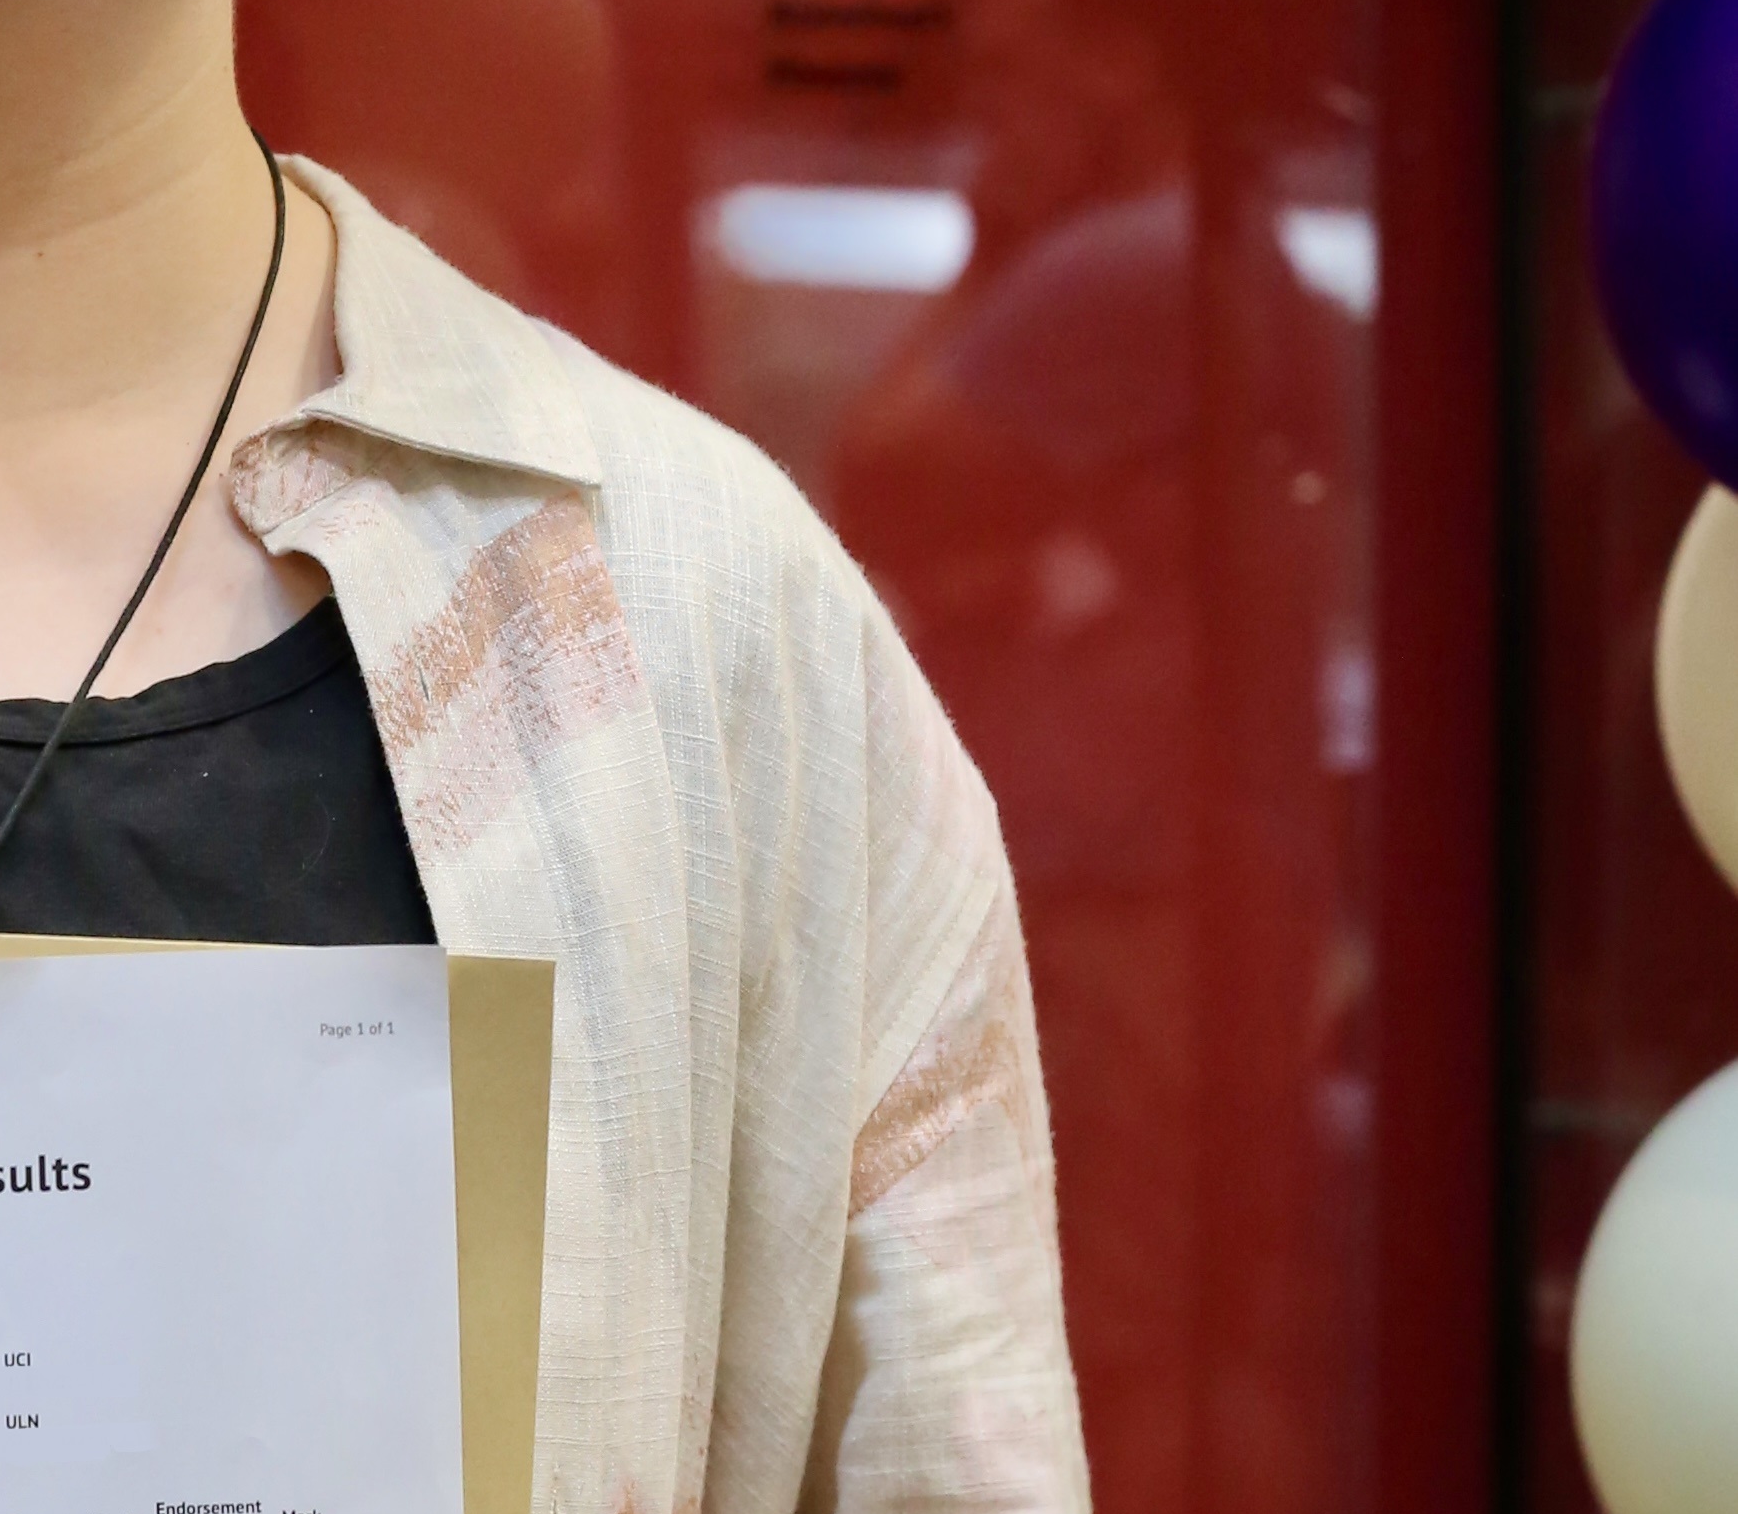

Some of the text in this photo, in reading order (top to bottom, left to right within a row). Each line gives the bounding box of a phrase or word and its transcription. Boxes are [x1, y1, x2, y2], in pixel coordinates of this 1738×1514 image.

[320, 1022, 394, 1039] Page 1 of 1
[4, 1352, 31, 1367] UCI
[6, 1414, 39, 1429] ULN
